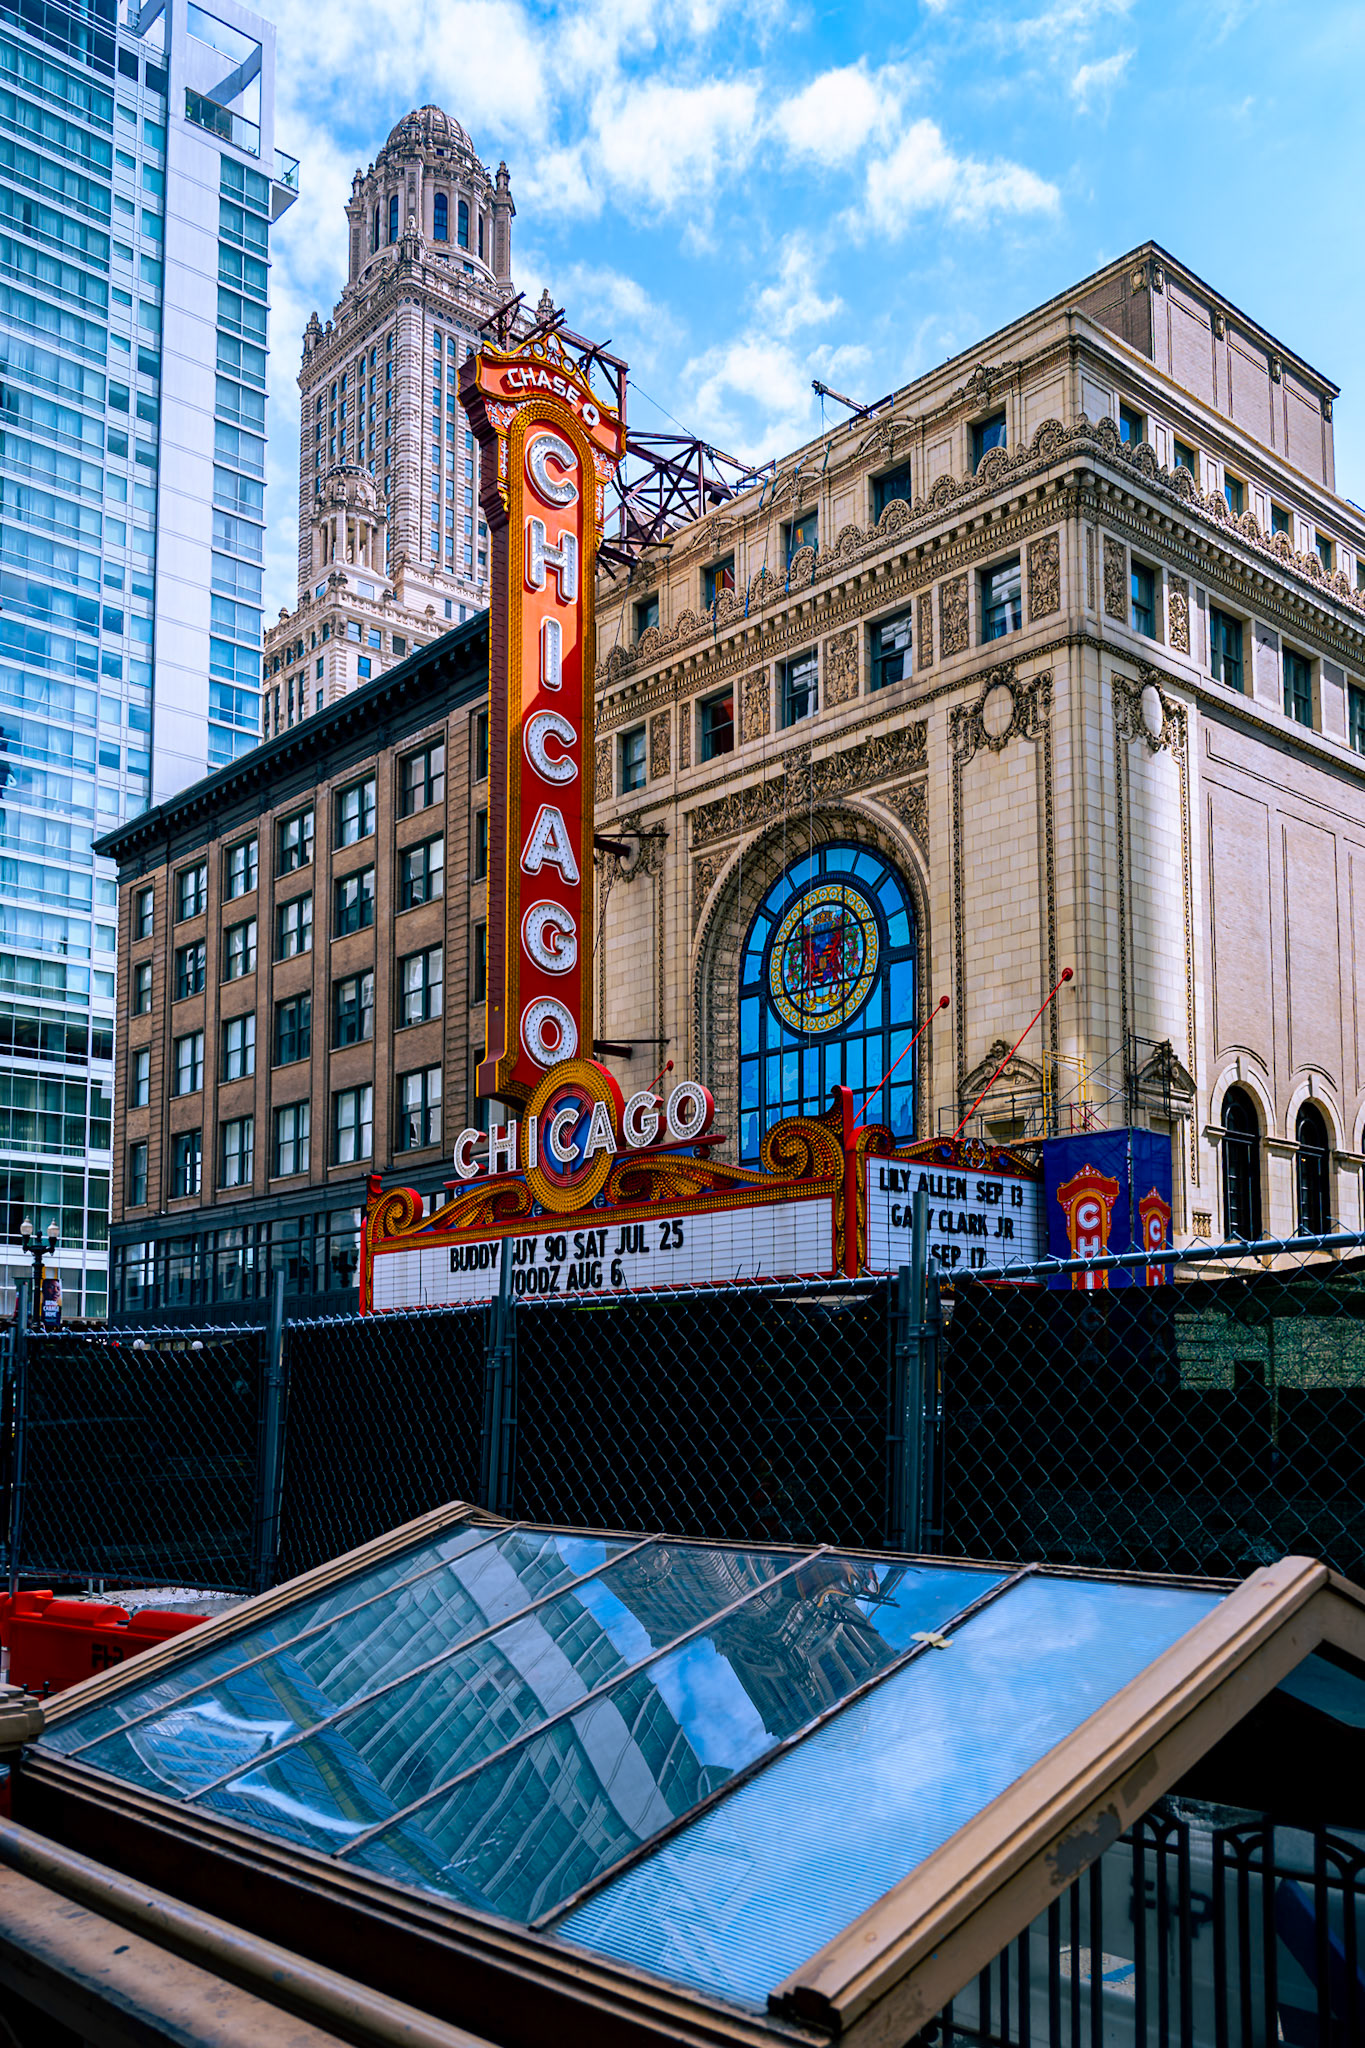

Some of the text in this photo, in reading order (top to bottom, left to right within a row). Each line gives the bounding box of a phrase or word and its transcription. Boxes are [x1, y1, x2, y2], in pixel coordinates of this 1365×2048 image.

[507, 367, 581, 407] CHASE
[520, 431, 580, 1071] CHICAGO
[453, 1080, 708, 1179] CHICAGO
[918, 1172, 967, 1200] ALLEN
[976, 1181, 1003, 1204] SEP
[1011, 1185, 1023, 1207] 13
[891, 1204, 1015, 1239] GAY CLARK JR
[450, 1219, 684, 1273] BUDDY UY 90 SAT JUL 25
[931, 1244, 986, 1268] SEP 17
[512, 1257, 623, 1295] OODZ AUG 6
